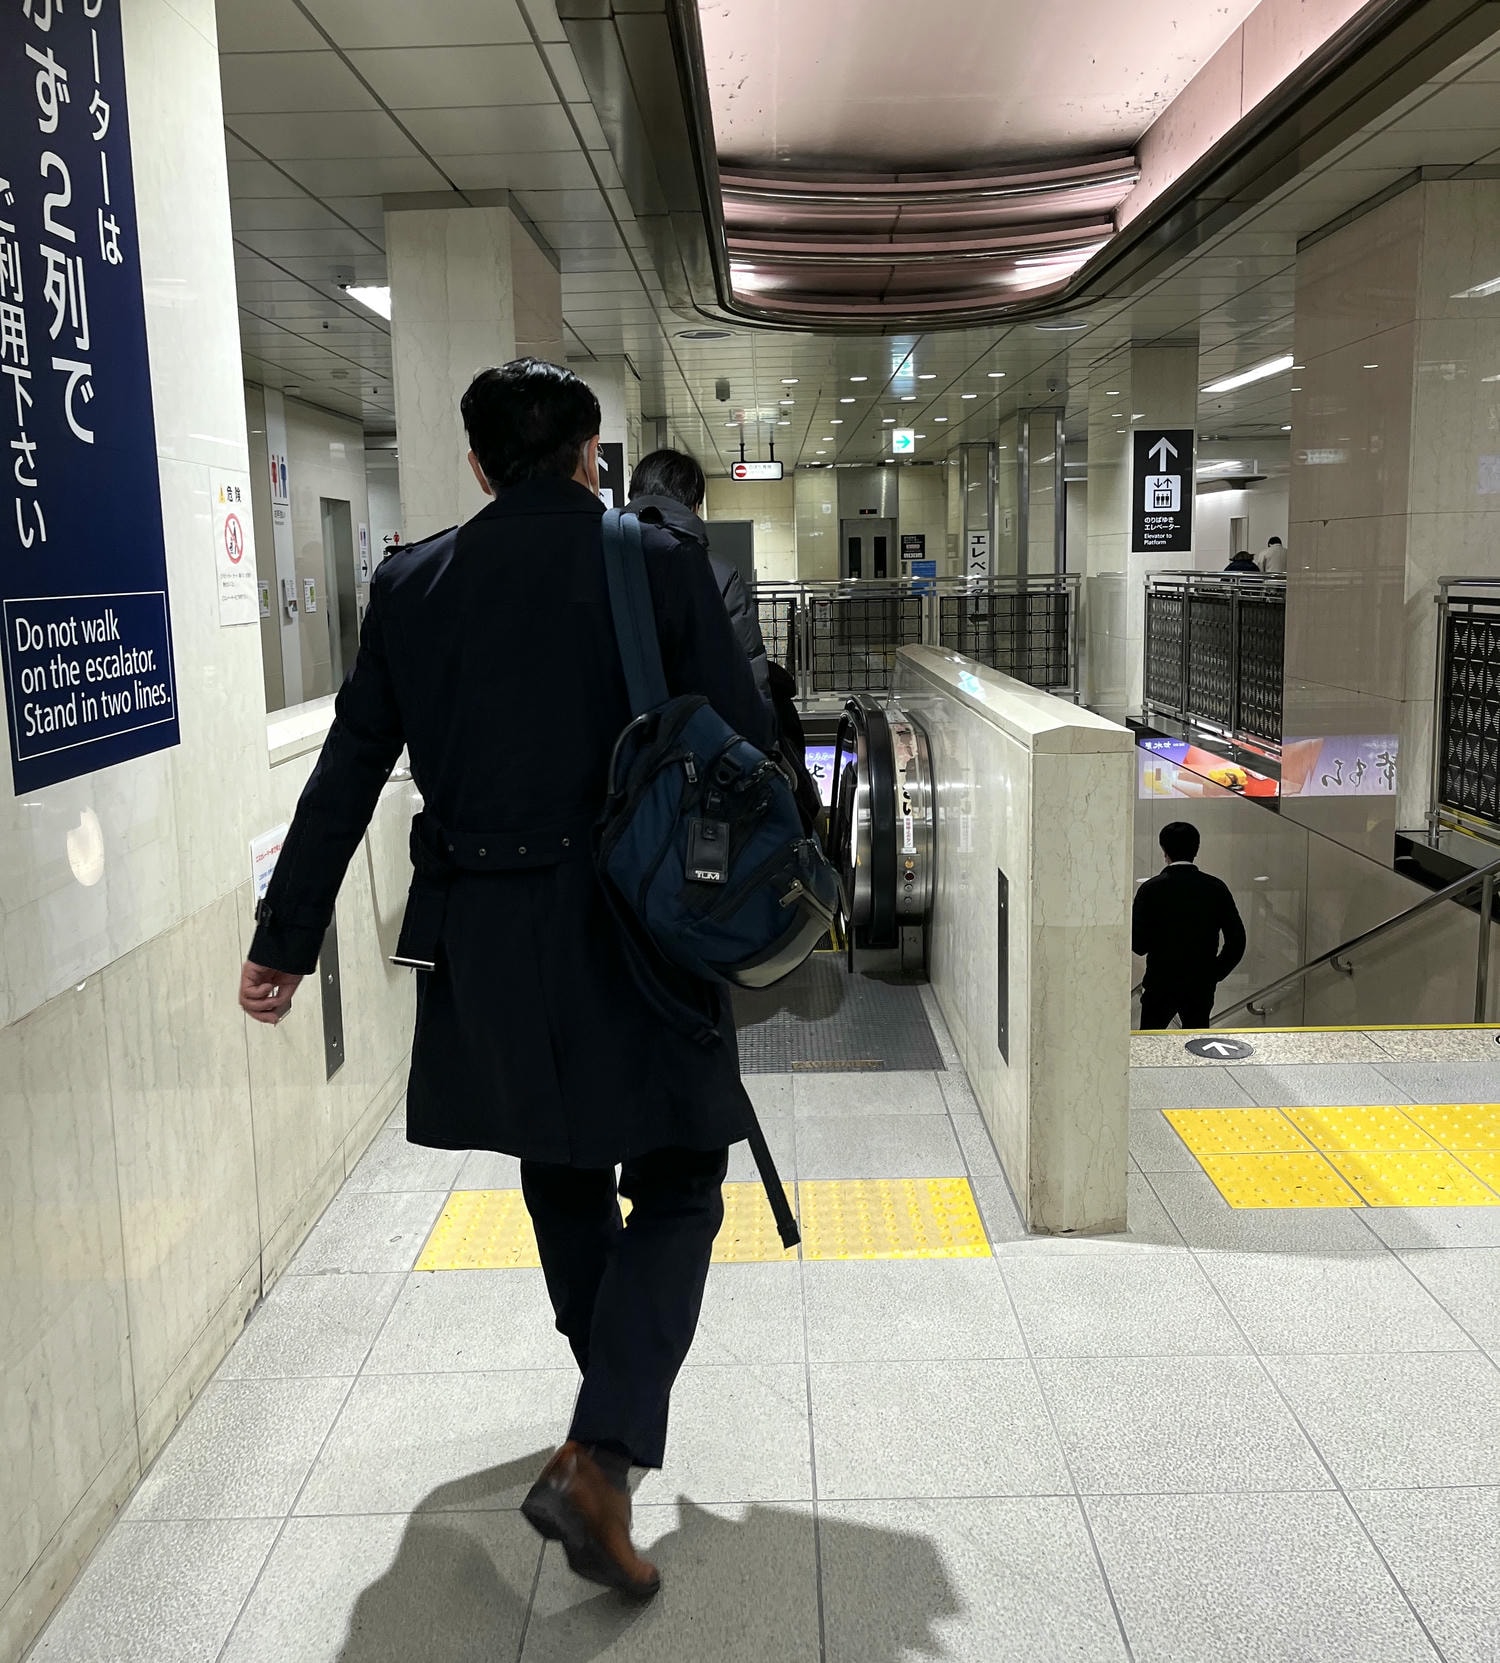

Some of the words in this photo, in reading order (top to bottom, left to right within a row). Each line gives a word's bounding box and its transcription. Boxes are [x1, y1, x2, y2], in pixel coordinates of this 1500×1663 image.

[15, 617, 44, 653] Do
[47, 612, 78, 647] not
[81, 608, 121, 643] walk
[21, 665, 47, 694] on
[49, 653, 81, 690] the
[85, 646, 157, 682] escalator.
[24, 692, 78, 738] Stand
[81, 691, 98, 724] in
[100, 690, 132, 720] two
[133, 678, 172, 711] lines.
